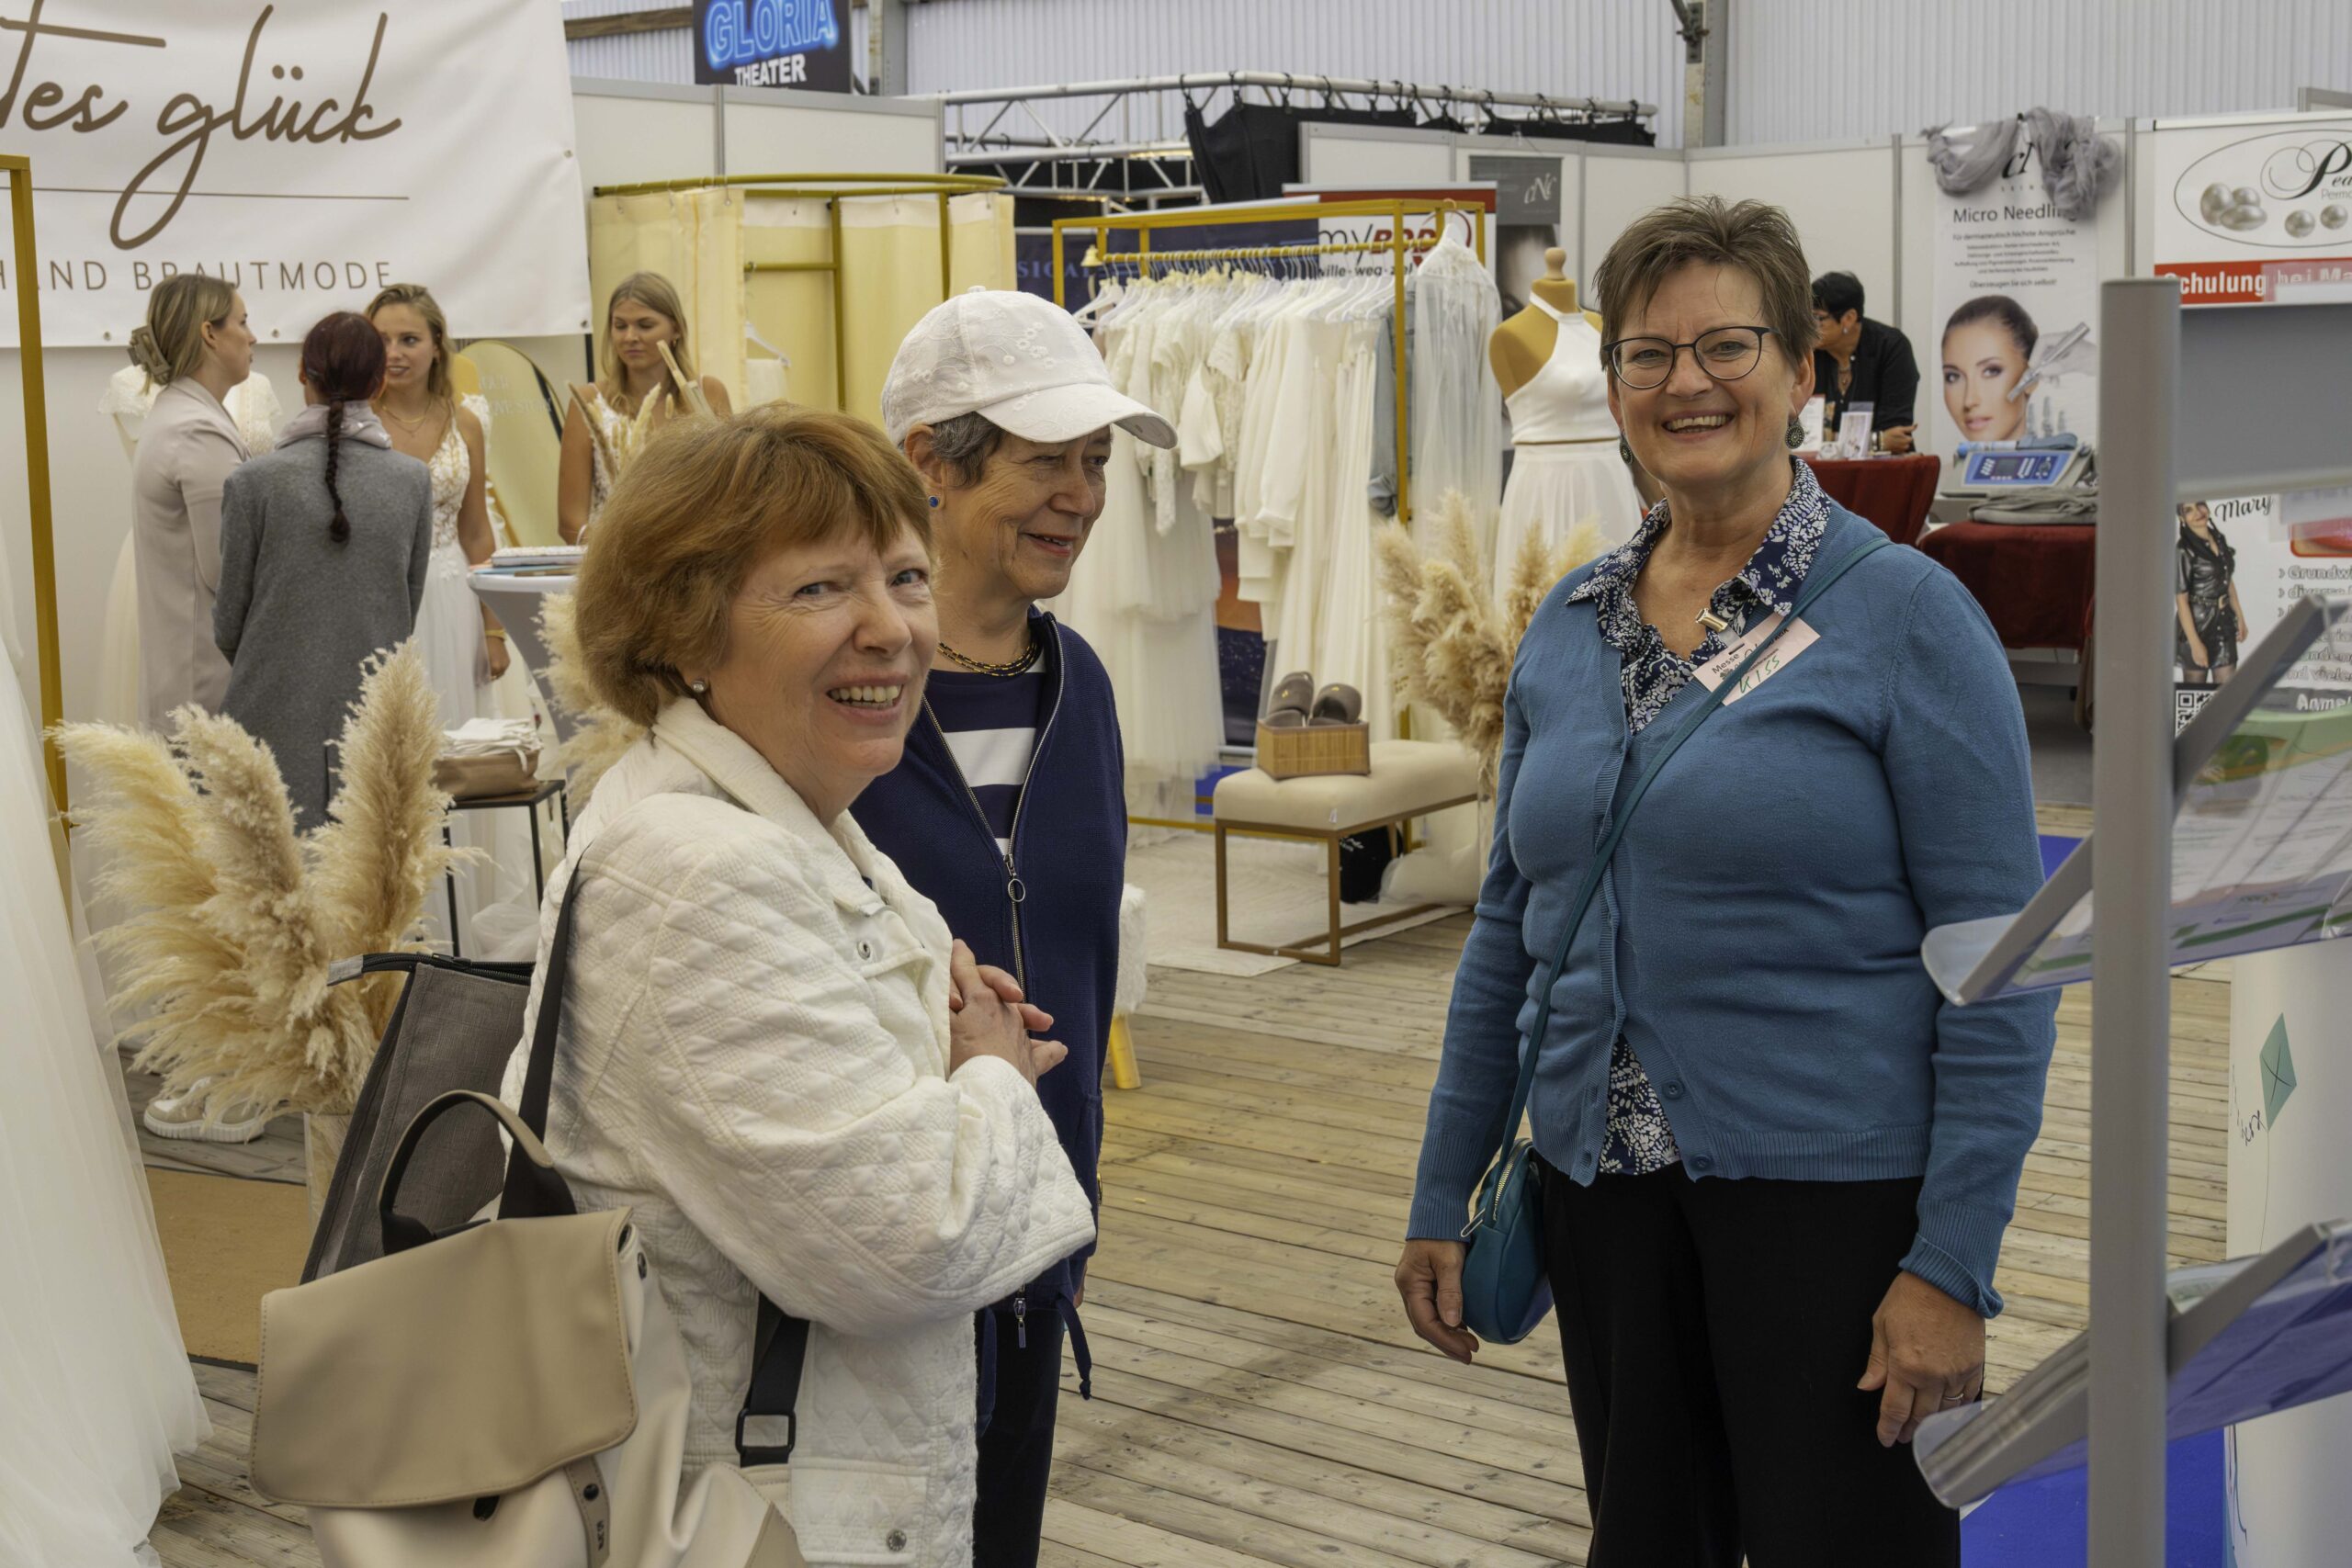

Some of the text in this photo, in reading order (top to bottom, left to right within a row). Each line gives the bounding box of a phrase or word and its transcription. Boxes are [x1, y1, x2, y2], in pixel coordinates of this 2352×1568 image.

[707, 0, 835, 62] GLORIA
[734, 53, 807, 87] THEATER
[109, 4, 402, 250] glück
[1953, 202, 2077, 223] Micro Needli
[2165, 270, 2267, 297] chulung
[2214, 495, 2274, 522] Mary
[1712, 653, 1739, 674] Messe
